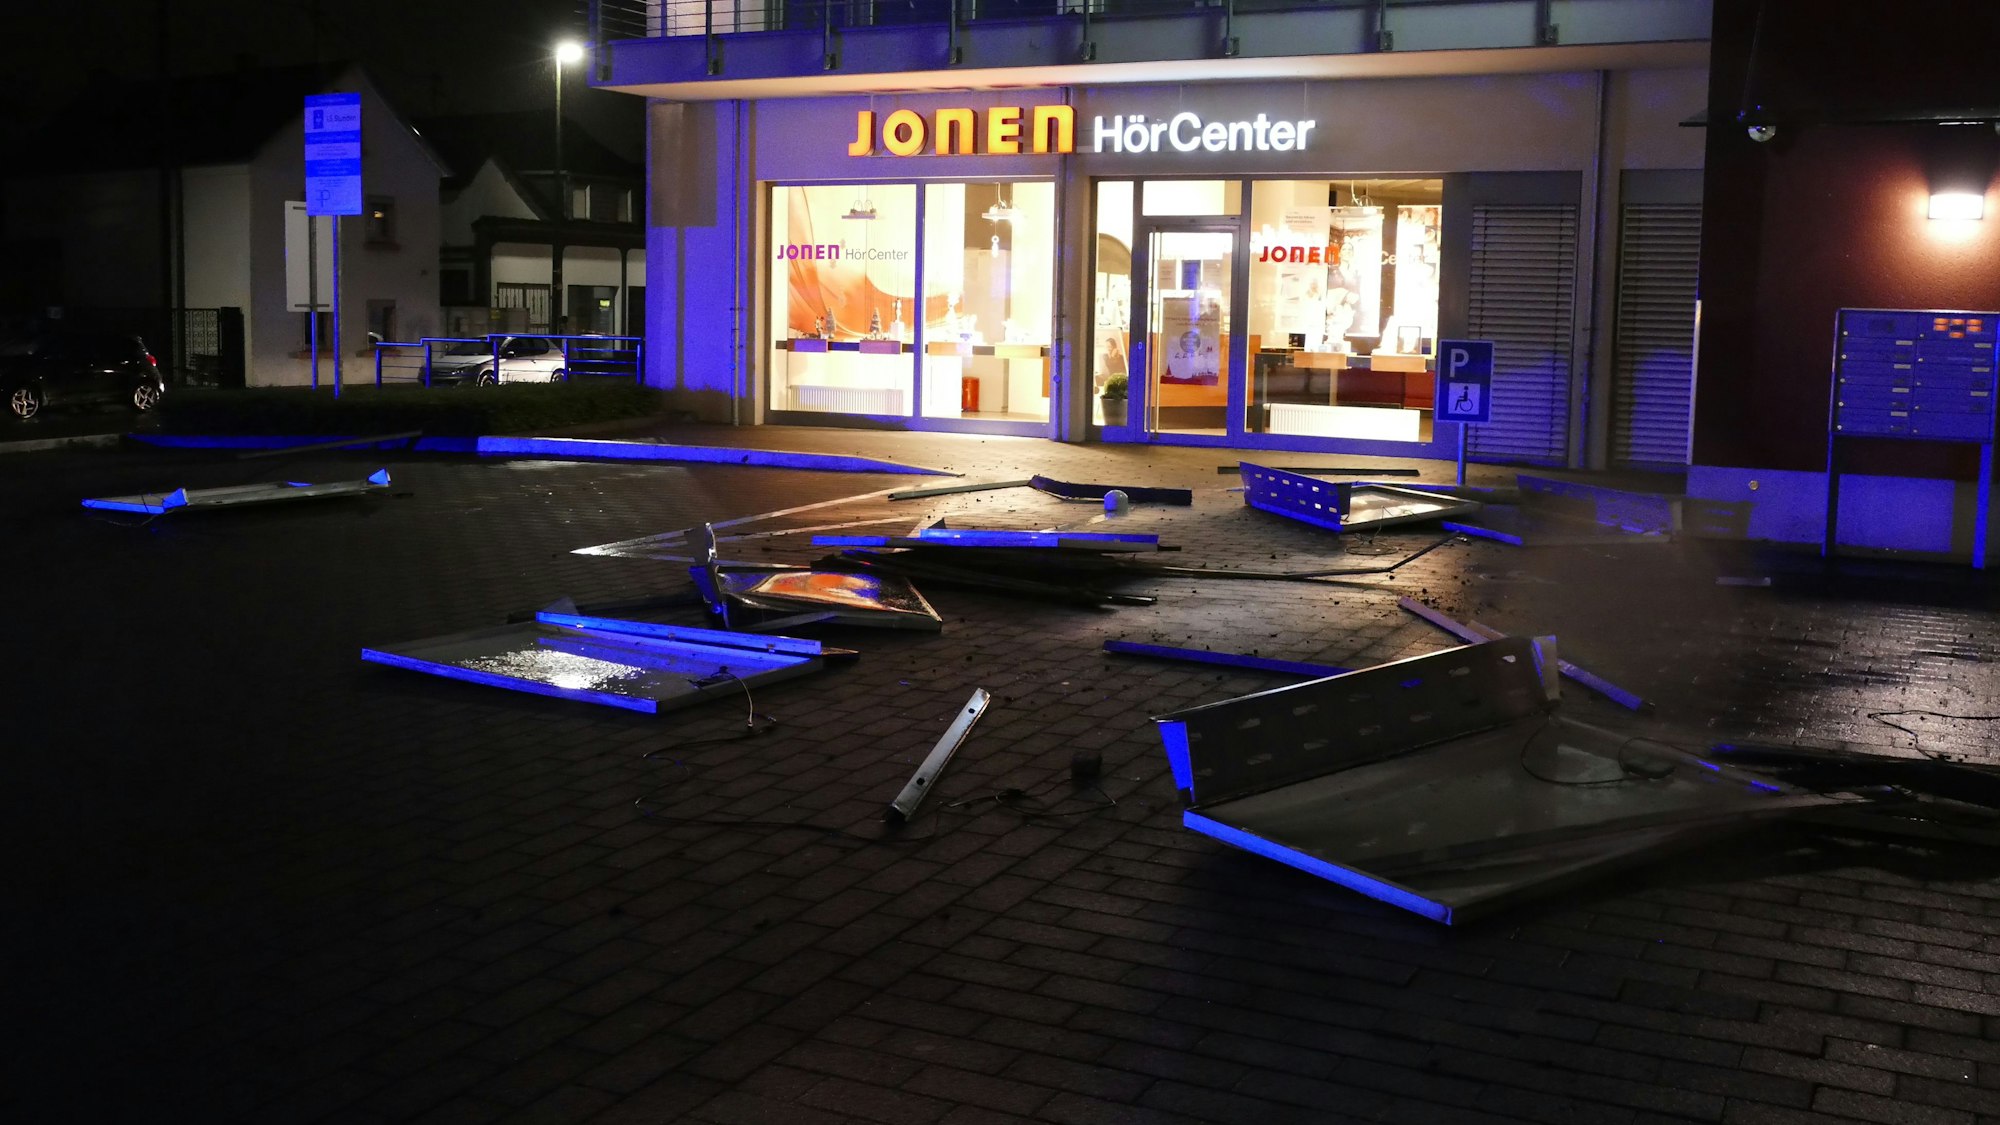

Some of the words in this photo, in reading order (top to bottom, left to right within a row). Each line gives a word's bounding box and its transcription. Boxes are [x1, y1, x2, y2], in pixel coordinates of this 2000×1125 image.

[848, 105, 1076, 157] JONEN
[1094, 112, 1316, 153] HörCenter
[777, 244, 840, 260] JONEN
[1259, 245, 1340, 264] JONEN
[1449, 348, 1470, 378] P
